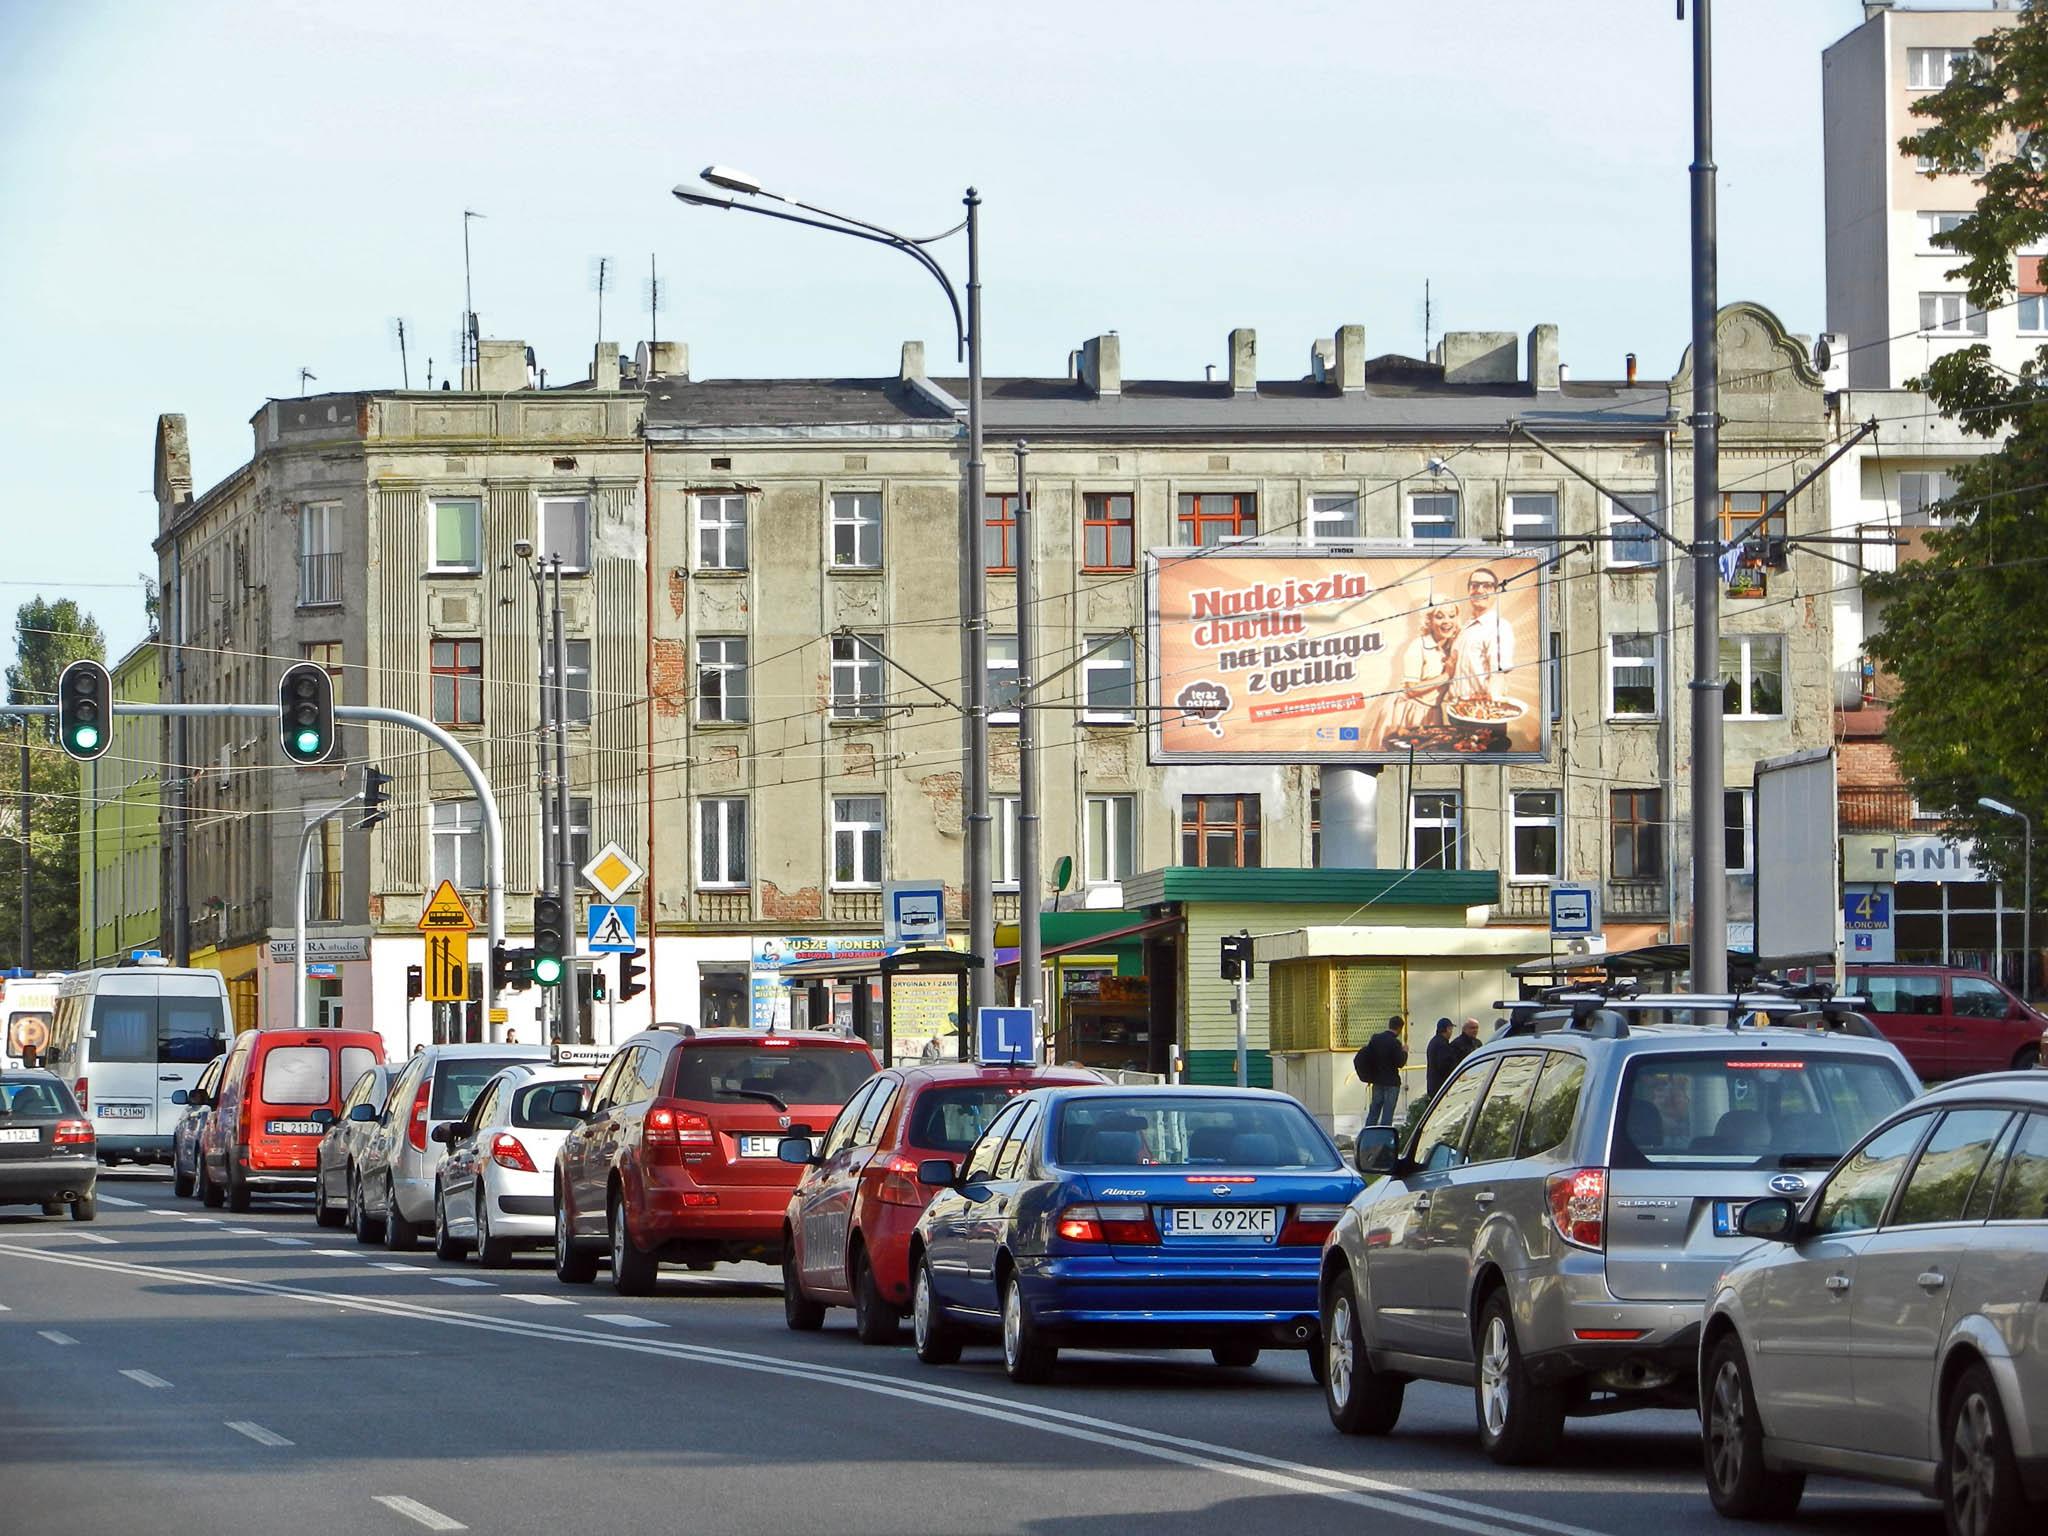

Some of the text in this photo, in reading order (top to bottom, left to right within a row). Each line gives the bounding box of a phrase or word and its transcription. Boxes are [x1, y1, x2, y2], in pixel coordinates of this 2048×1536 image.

[1195, 612, 1306, 646] chwila
[1220, 648, 1260, 671] na
[1249, 660, 1356, 693] z grilla
[1191, 689, 1218, 700] teraz
[1855, 894, 1872, 920] 4
[270, 942, 326, 953] SPERA
[784, 939, 827, 951] TUSZE
[1861, 937, 1867, 946] 4
[998, 1018, 1021, 1052] L
[104, 1107, 115, 1116] EL
[274, 1123, 285, 1133] EL
[751, 1137, 771, 1152] EL
[1102, 1187, 1147, 1197] Almera
[1616, 1200, 1678, 1208] SUBARU
[1176, 1210, 1273, 1230] EL 692KF
